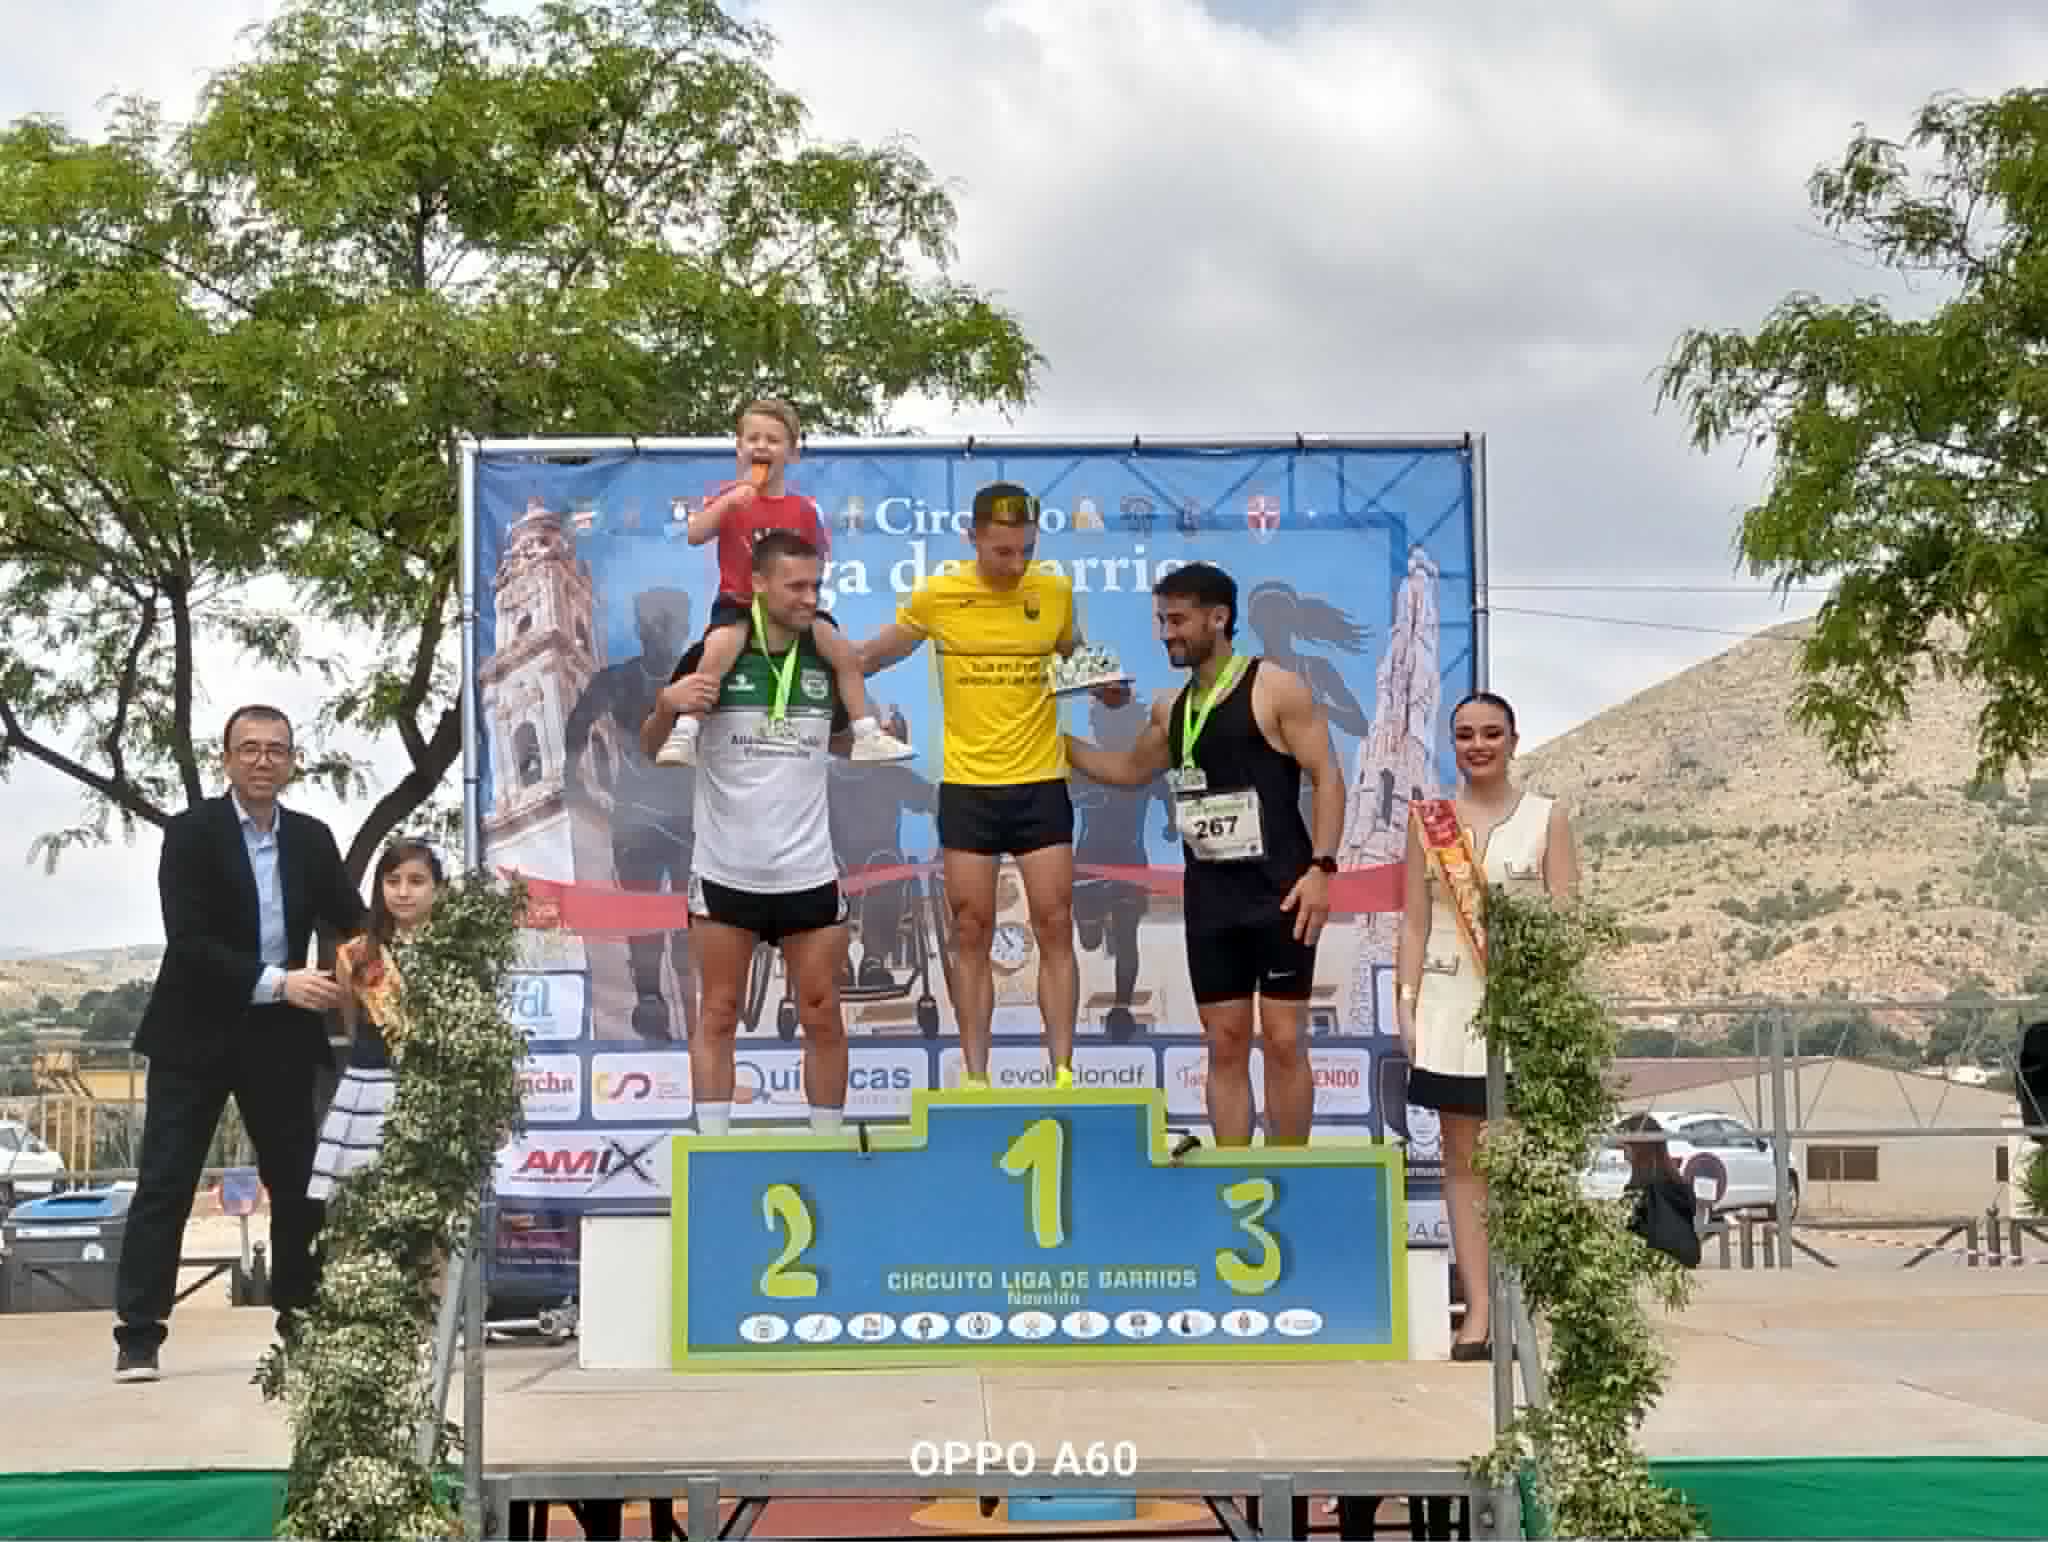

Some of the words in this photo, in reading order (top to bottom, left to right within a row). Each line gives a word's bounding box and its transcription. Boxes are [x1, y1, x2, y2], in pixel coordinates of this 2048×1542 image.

[1195, 815, 1239, 840] 267
[519, 1136, 664, 1192] AMIX
[998, 1118, 1065, 1249] 1
[759, 1183, 819, 1299] 2
[1215, 1177, 1282, 1296] 3
[887, 1271, 993, 1290] CIRCUITO
[1001, 1271, 1053, 1289] LIGA
[1061, 1271, 1089, 1289] DE
[1099, 1270, 1197, 1289] BARRIOS
